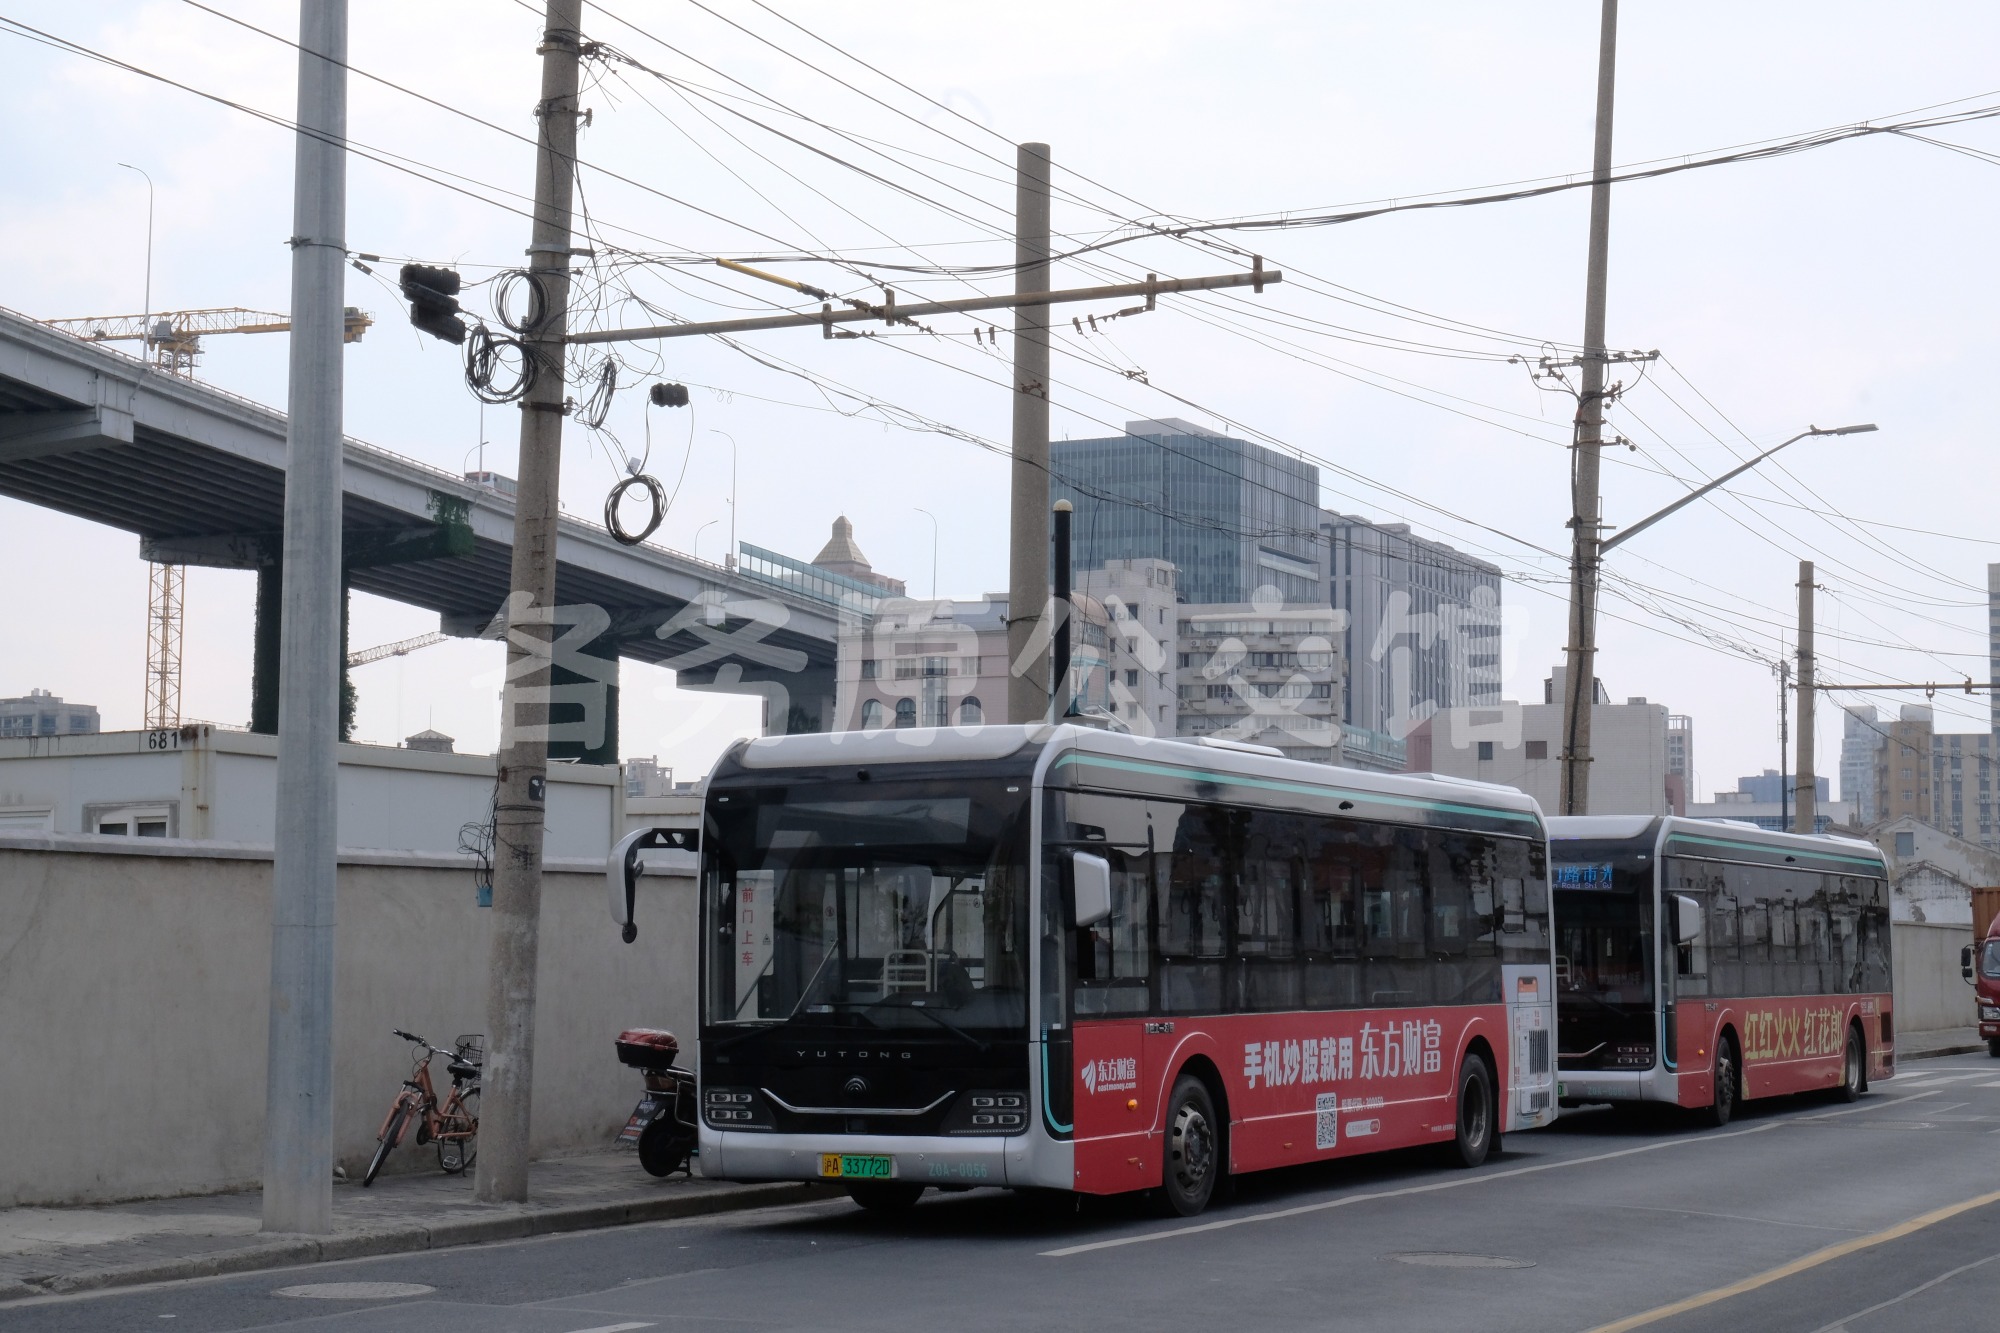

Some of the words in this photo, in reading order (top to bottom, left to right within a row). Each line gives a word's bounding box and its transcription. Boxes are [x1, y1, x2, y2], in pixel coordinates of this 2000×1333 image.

[148, 731, 178, 750] 681
[741, 887, 754, 967] 前门上车
[1743, 1007, 1801, 1060] 红红火火
[1803, 1005, 1843, 1057] 红花郎
[796, 1050, 911, 1059] YUTONG
[1243, 1036, 1353, 1090] 手机炒股就用
[1359, 1018, 1442, 1081] 东方财富
[1097, 1057, 1136, 1082] 东方财富
[1097, 1081, 1137, 1092] eastmoney.com
[824, 1157, 839, 1174] 沪A
[845, 1157, 890, 1176] 33772D
